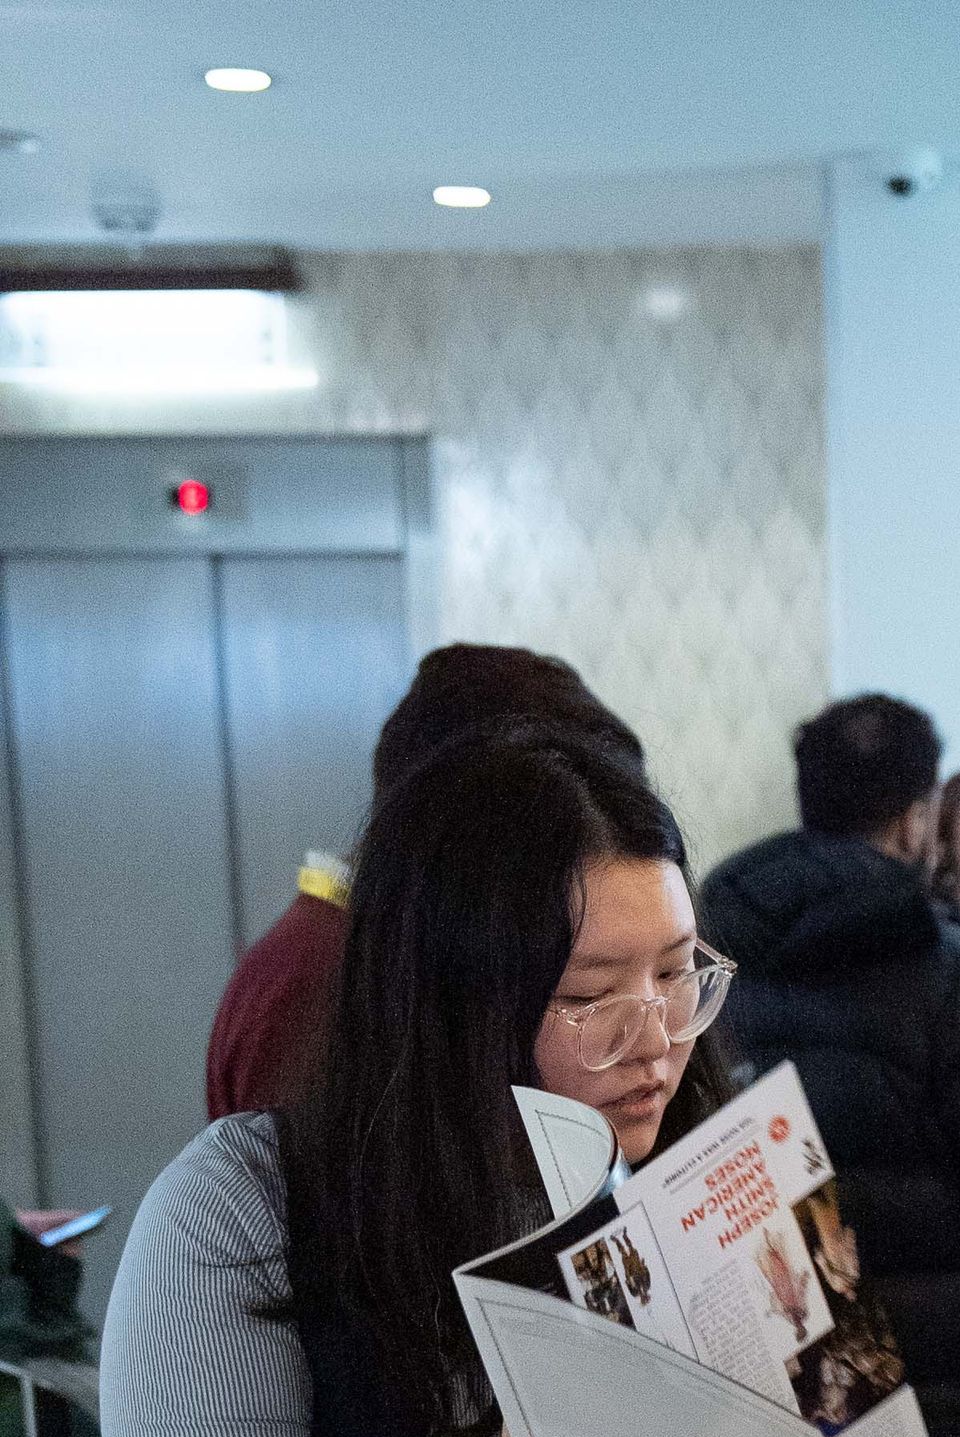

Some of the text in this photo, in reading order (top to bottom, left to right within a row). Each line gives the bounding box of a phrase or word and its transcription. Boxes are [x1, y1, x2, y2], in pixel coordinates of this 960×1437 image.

[704, 1139, 761, 1191] MOSES
[681, 1160, 766, 1233] AMERICAN
[723, 1174, 776, 1221] SMITH
[718, 1197, 779, 1249] JOSEPH
